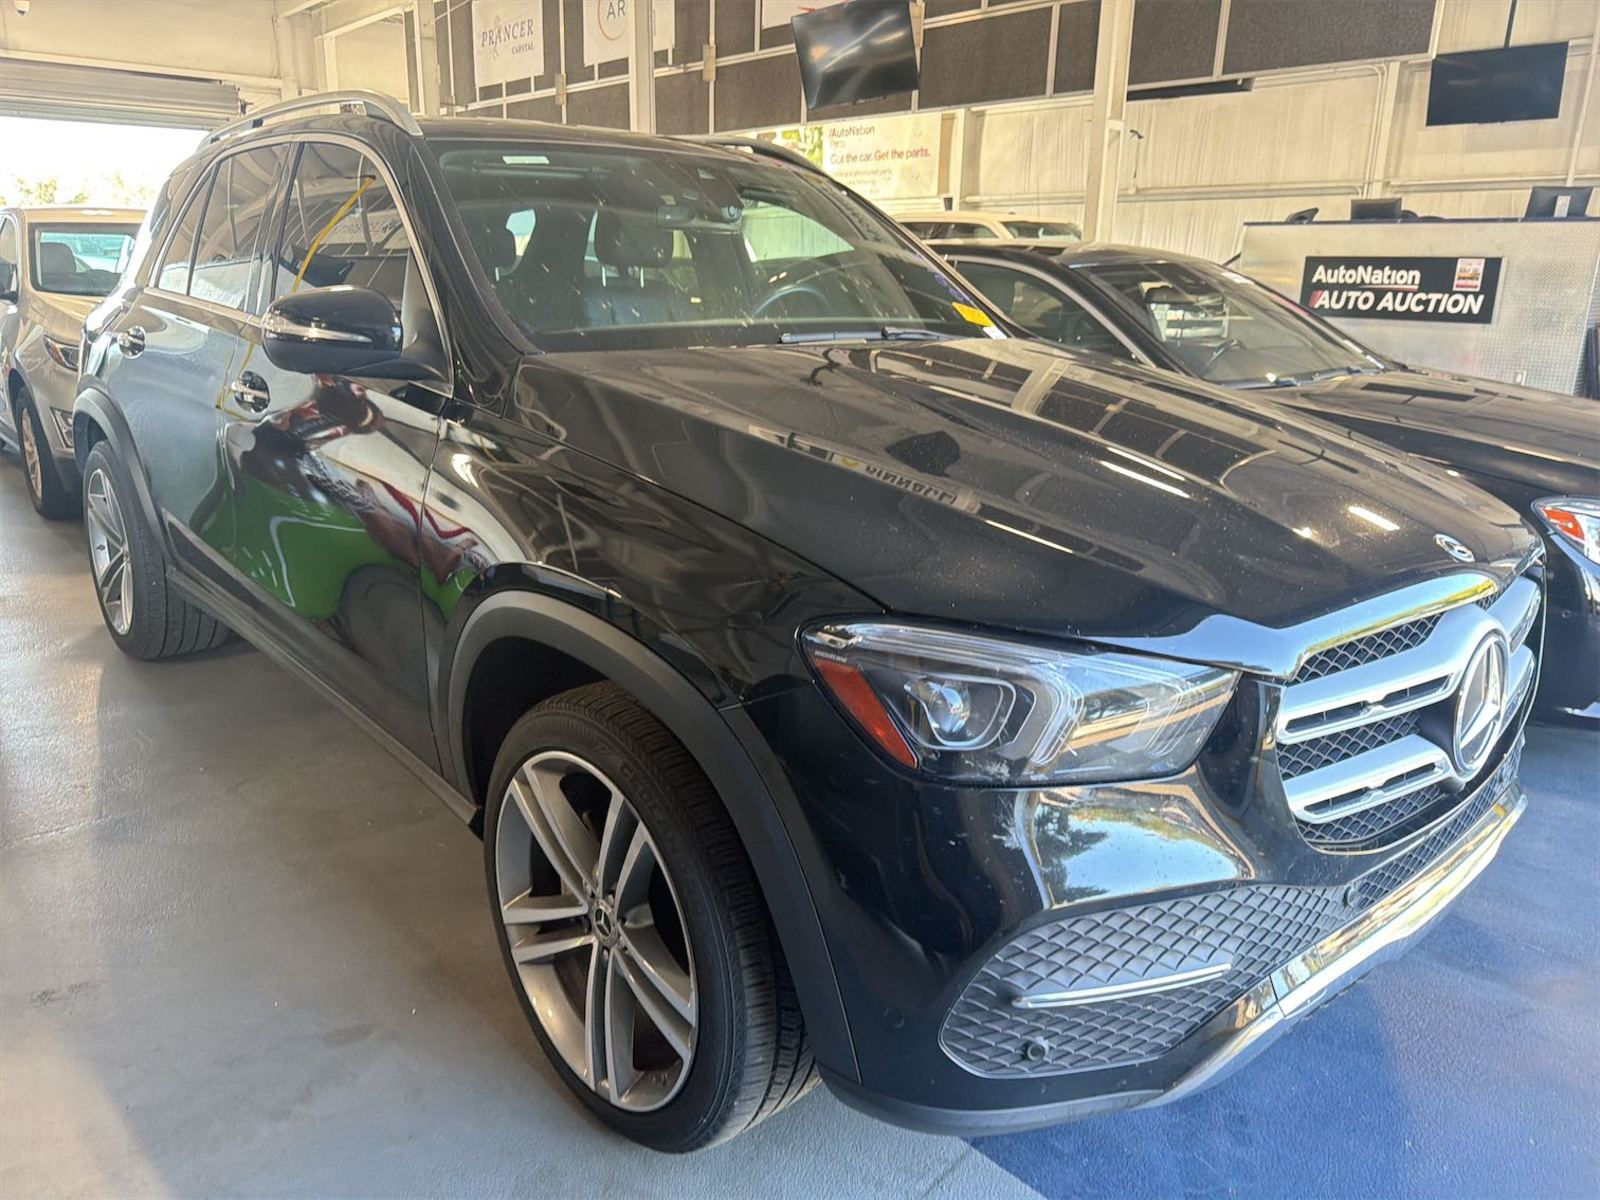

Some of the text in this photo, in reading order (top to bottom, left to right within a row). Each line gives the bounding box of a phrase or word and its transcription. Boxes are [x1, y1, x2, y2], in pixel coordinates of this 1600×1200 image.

[481, 18, 534, 48] PRANCER
[511, 41, 534, 55] CAPITAL
[845, 151, 858, 164] the
[874, 149, 890, 162] Get
[891, 147, 905, 161] the
[1311, 264, 1421, 286] AutoNation
[1312, 290, 1485, 316] AUTO AUCTION
